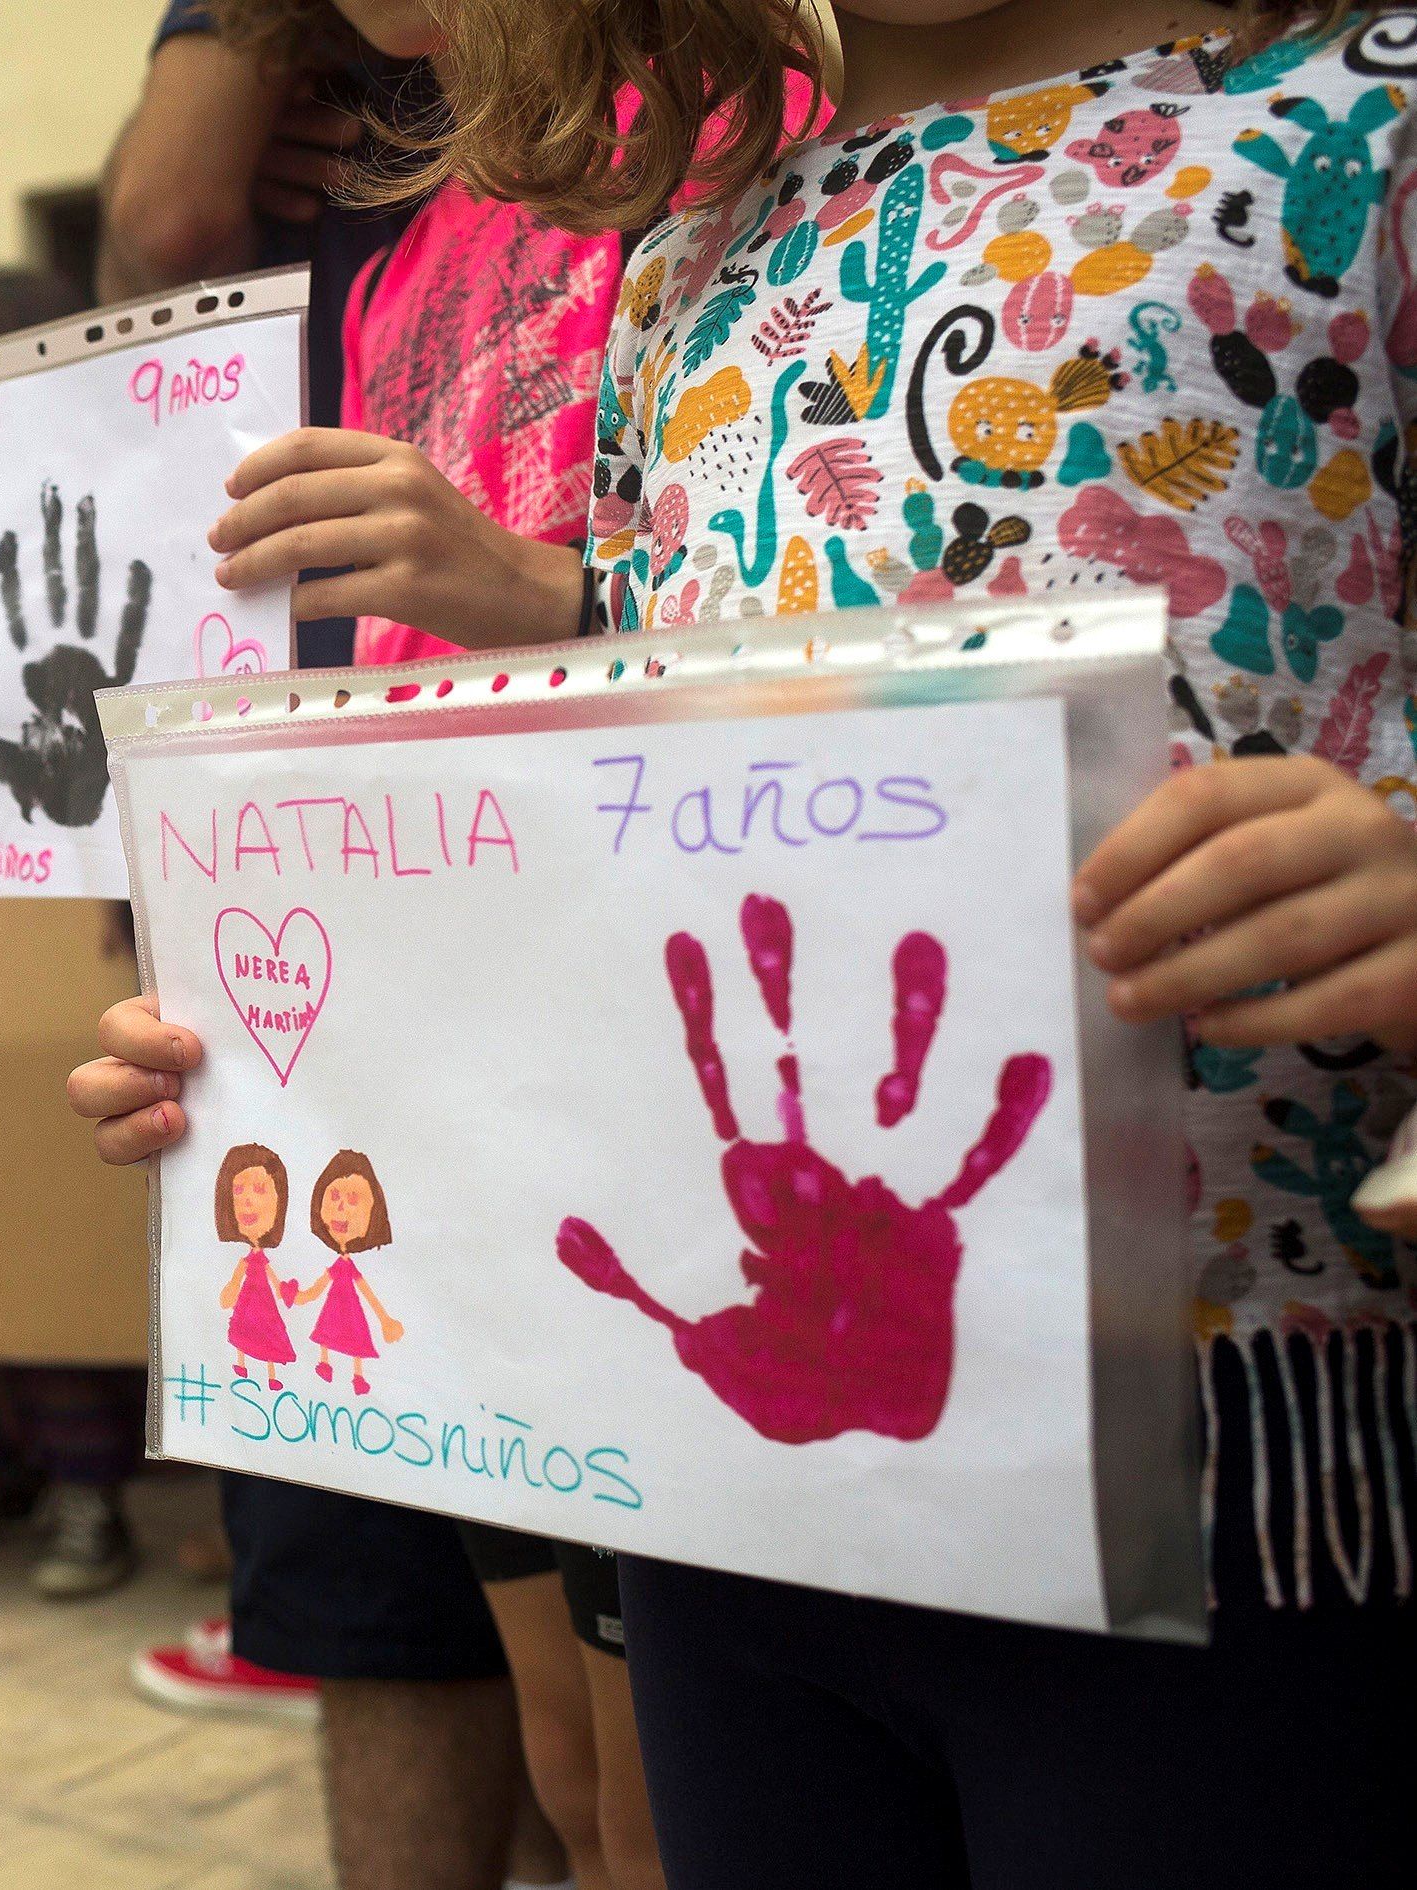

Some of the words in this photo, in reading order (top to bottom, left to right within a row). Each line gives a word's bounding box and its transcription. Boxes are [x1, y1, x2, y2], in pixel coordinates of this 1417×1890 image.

[129, 358, 164, 426] 9
[168, 353, 246, 416] AÑOS
[160, 789, 520, 883] NATALIA
[593, 755, 652, 855] 7
[670, 761, 949, 855] años
[234, 953, 311, 990] NEREA
